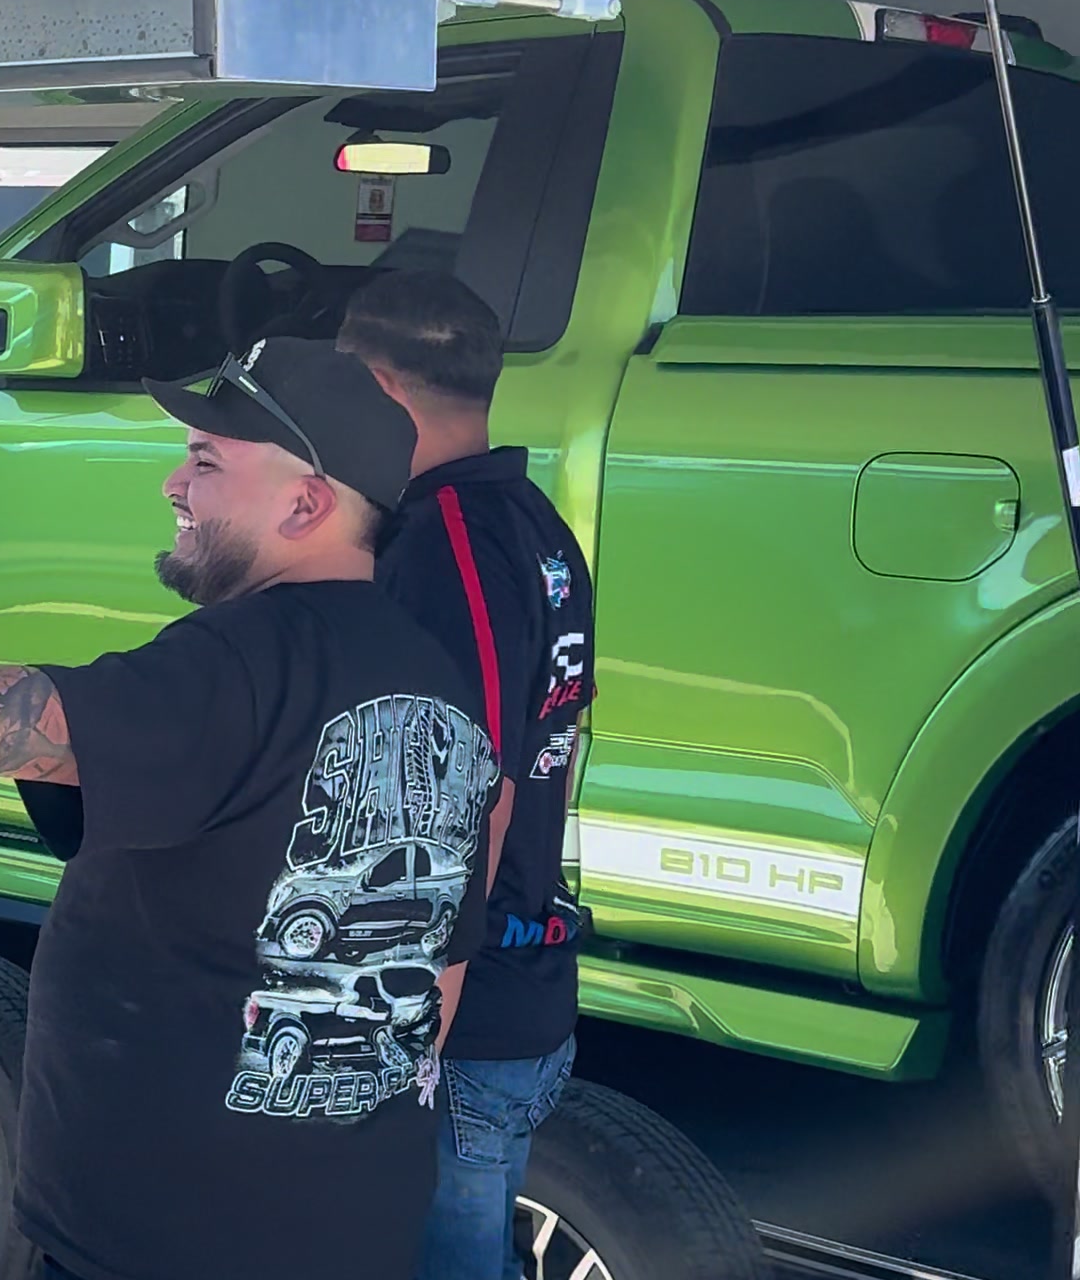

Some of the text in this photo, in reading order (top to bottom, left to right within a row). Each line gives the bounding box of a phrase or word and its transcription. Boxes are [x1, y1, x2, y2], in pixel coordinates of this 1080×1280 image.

[660, 847, 843, 894] 810 HP
[225, 1070, 379, 1116] SUPER
